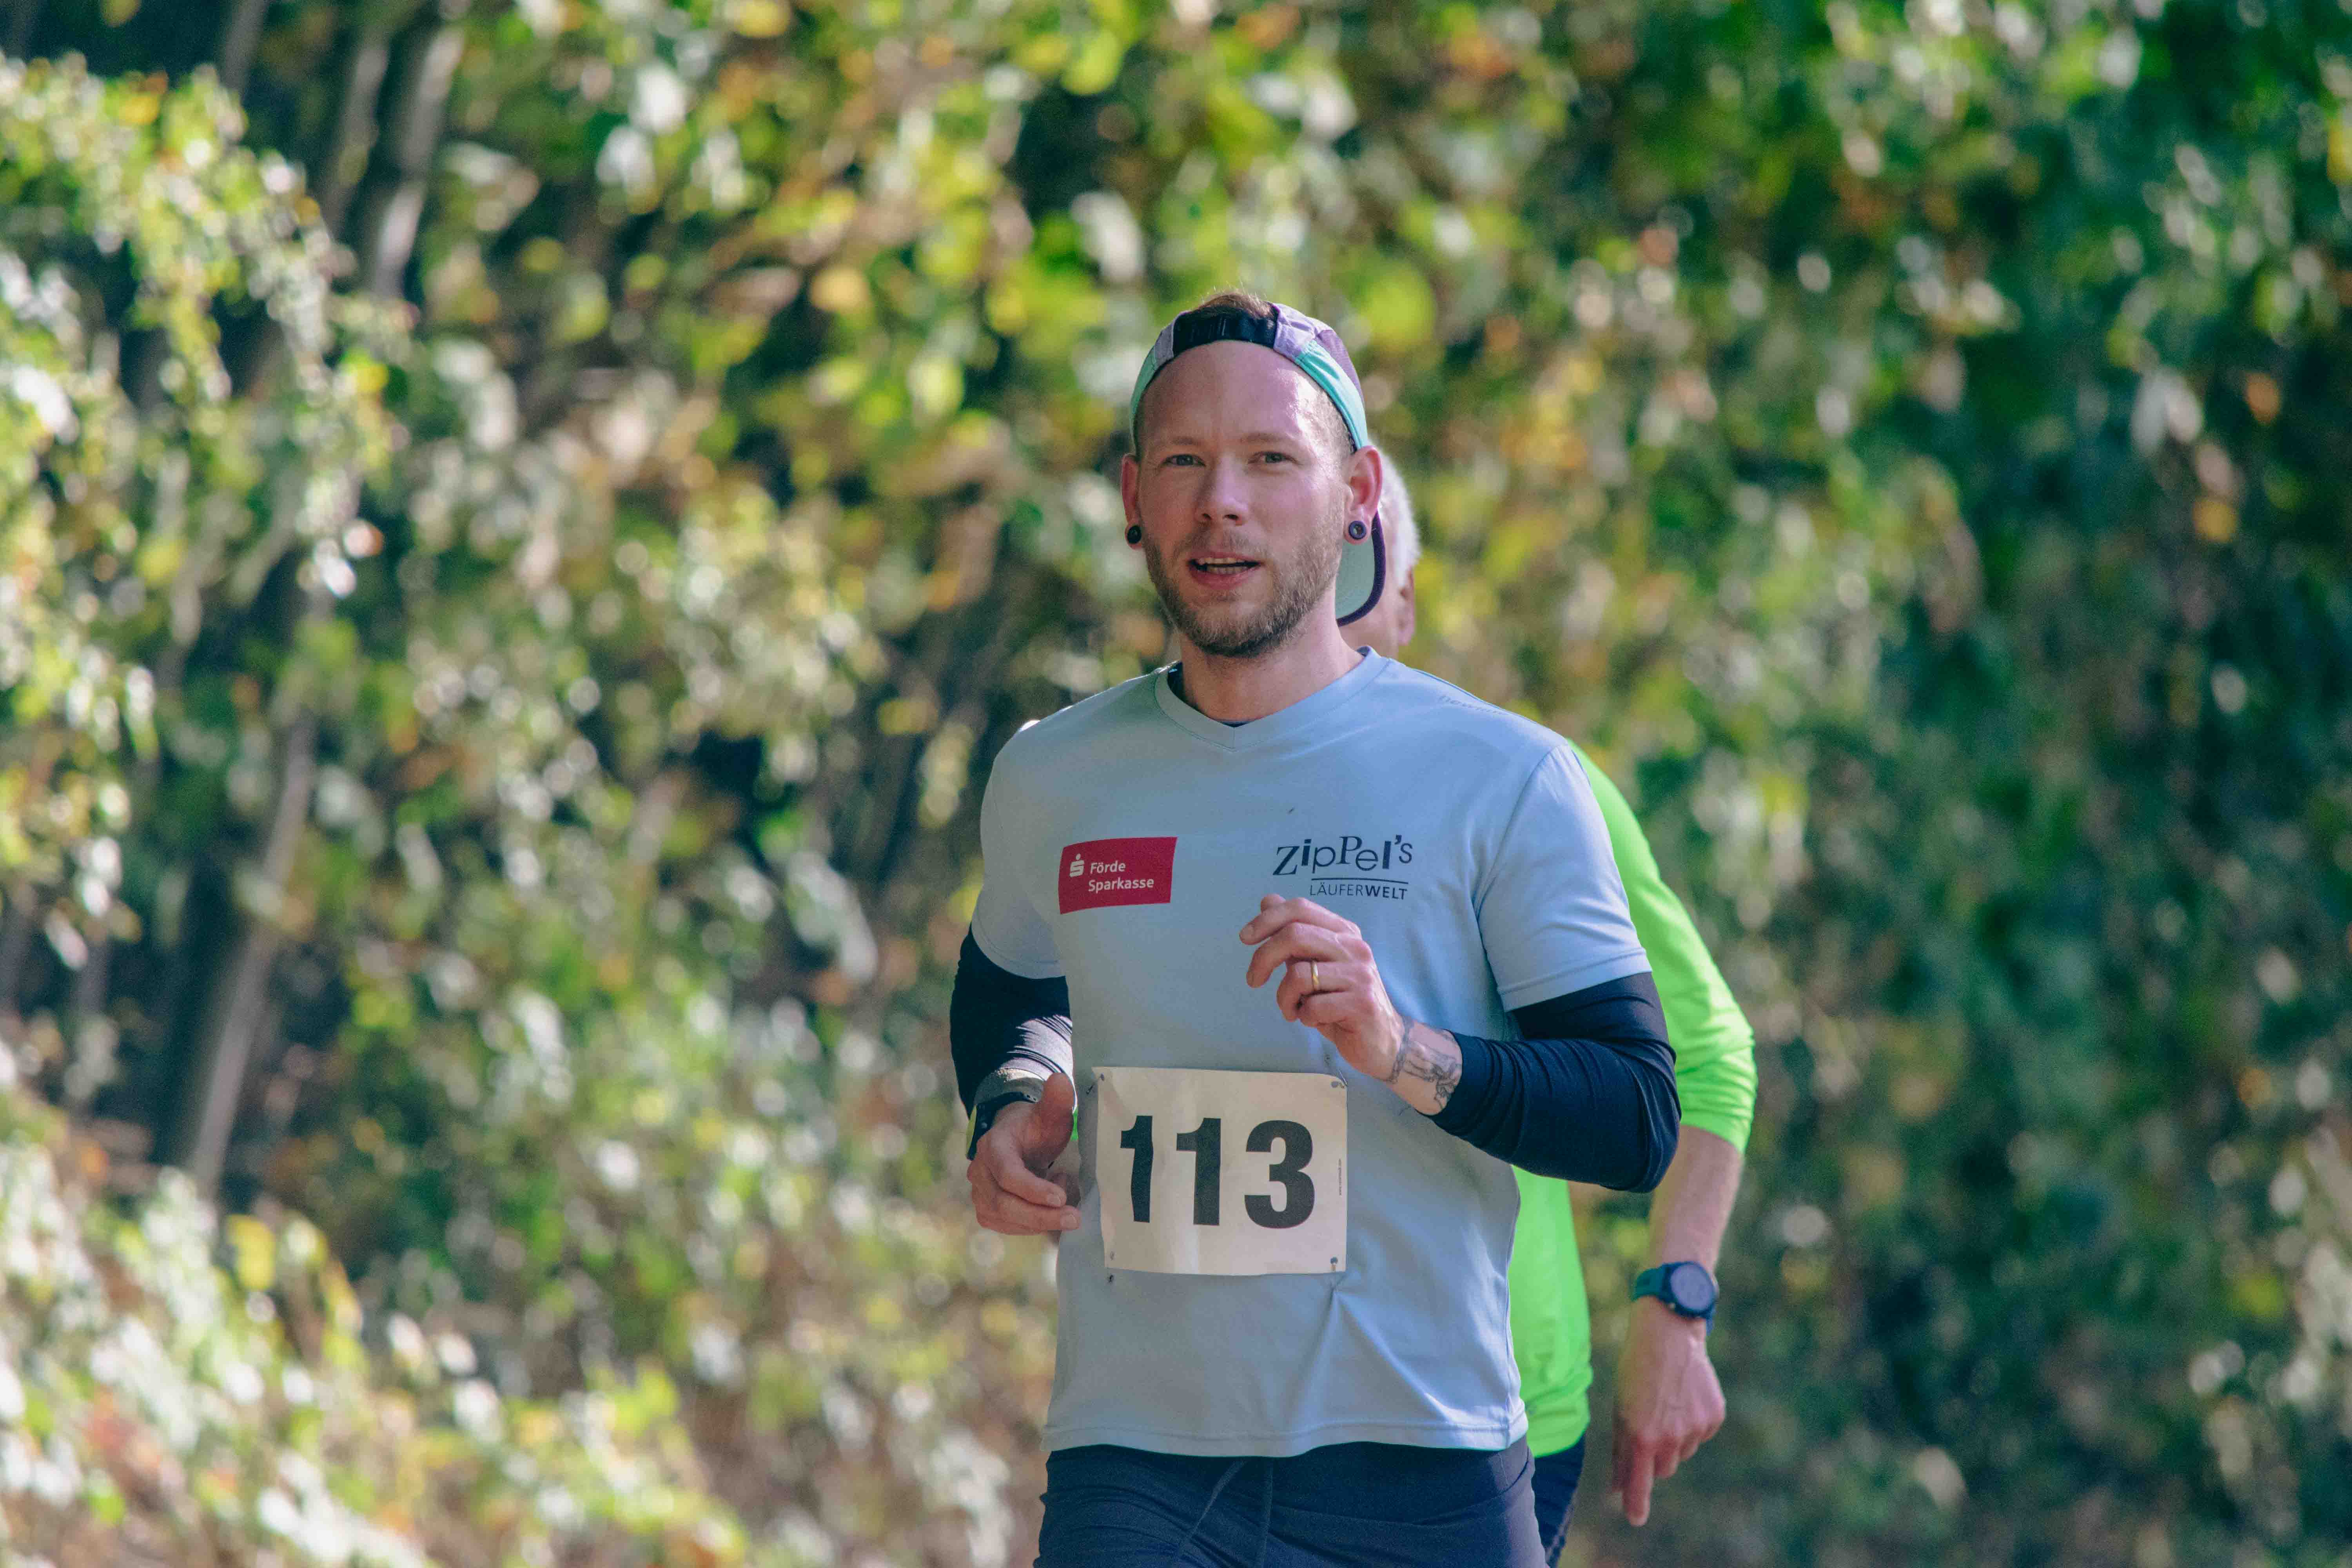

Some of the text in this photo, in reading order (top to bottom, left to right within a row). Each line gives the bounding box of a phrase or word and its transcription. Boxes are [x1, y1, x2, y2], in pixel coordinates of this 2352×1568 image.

[1090, 860, 1126, 874] Förde
[1088, 877, 1154, 893] Sparkasse
[1309, 882, 1408, 900] LÄUFERWELT
[1120, 1115, 1315, 1229] 113
